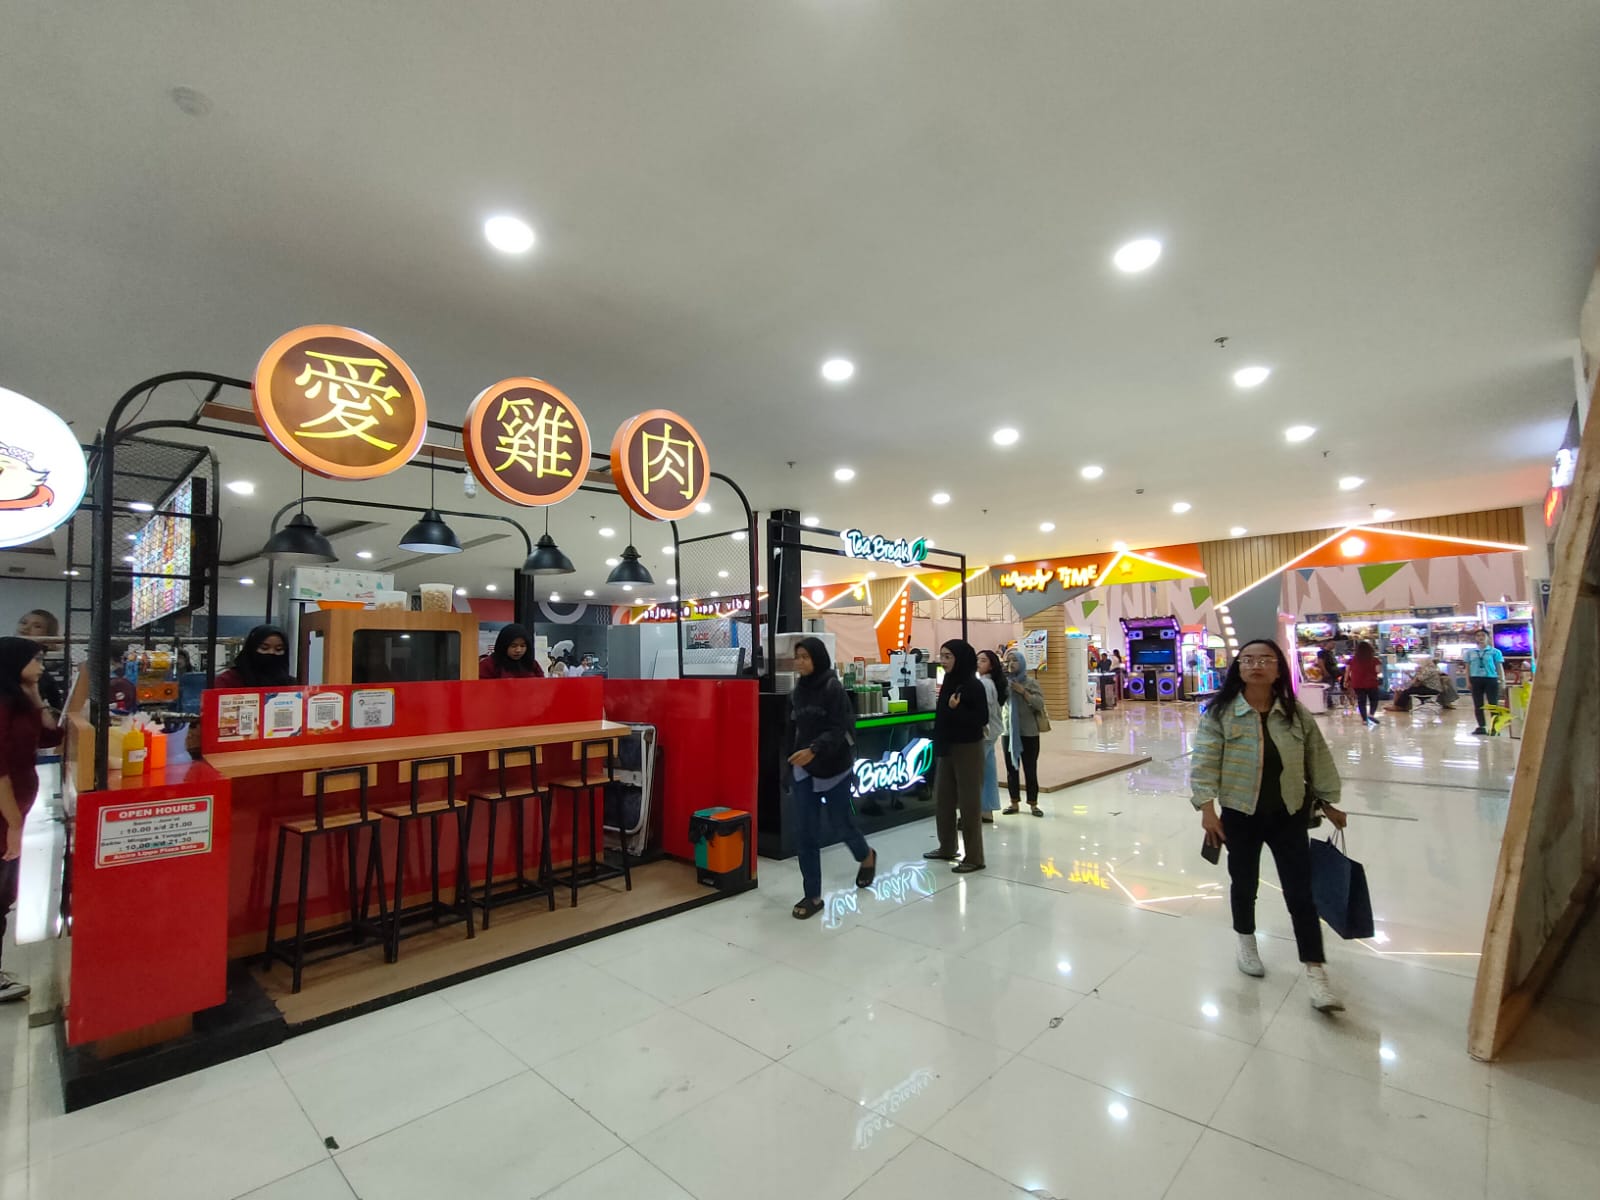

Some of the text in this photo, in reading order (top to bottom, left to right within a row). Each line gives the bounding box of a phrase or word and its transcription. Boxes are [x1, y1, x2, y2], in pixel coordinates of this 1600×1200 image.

[295, 350, 696, 500] 愛 雞 肉
[847, 530, 909, 562] Tea Break
[643, 608, 672, 619] enjoy
[857, 754, 909, 794] Break
[119, 803, 196, 819] OPEN HOURS
[127, 826, 151, 834] 10.00
[169, 821, 193, 829] 21.00
